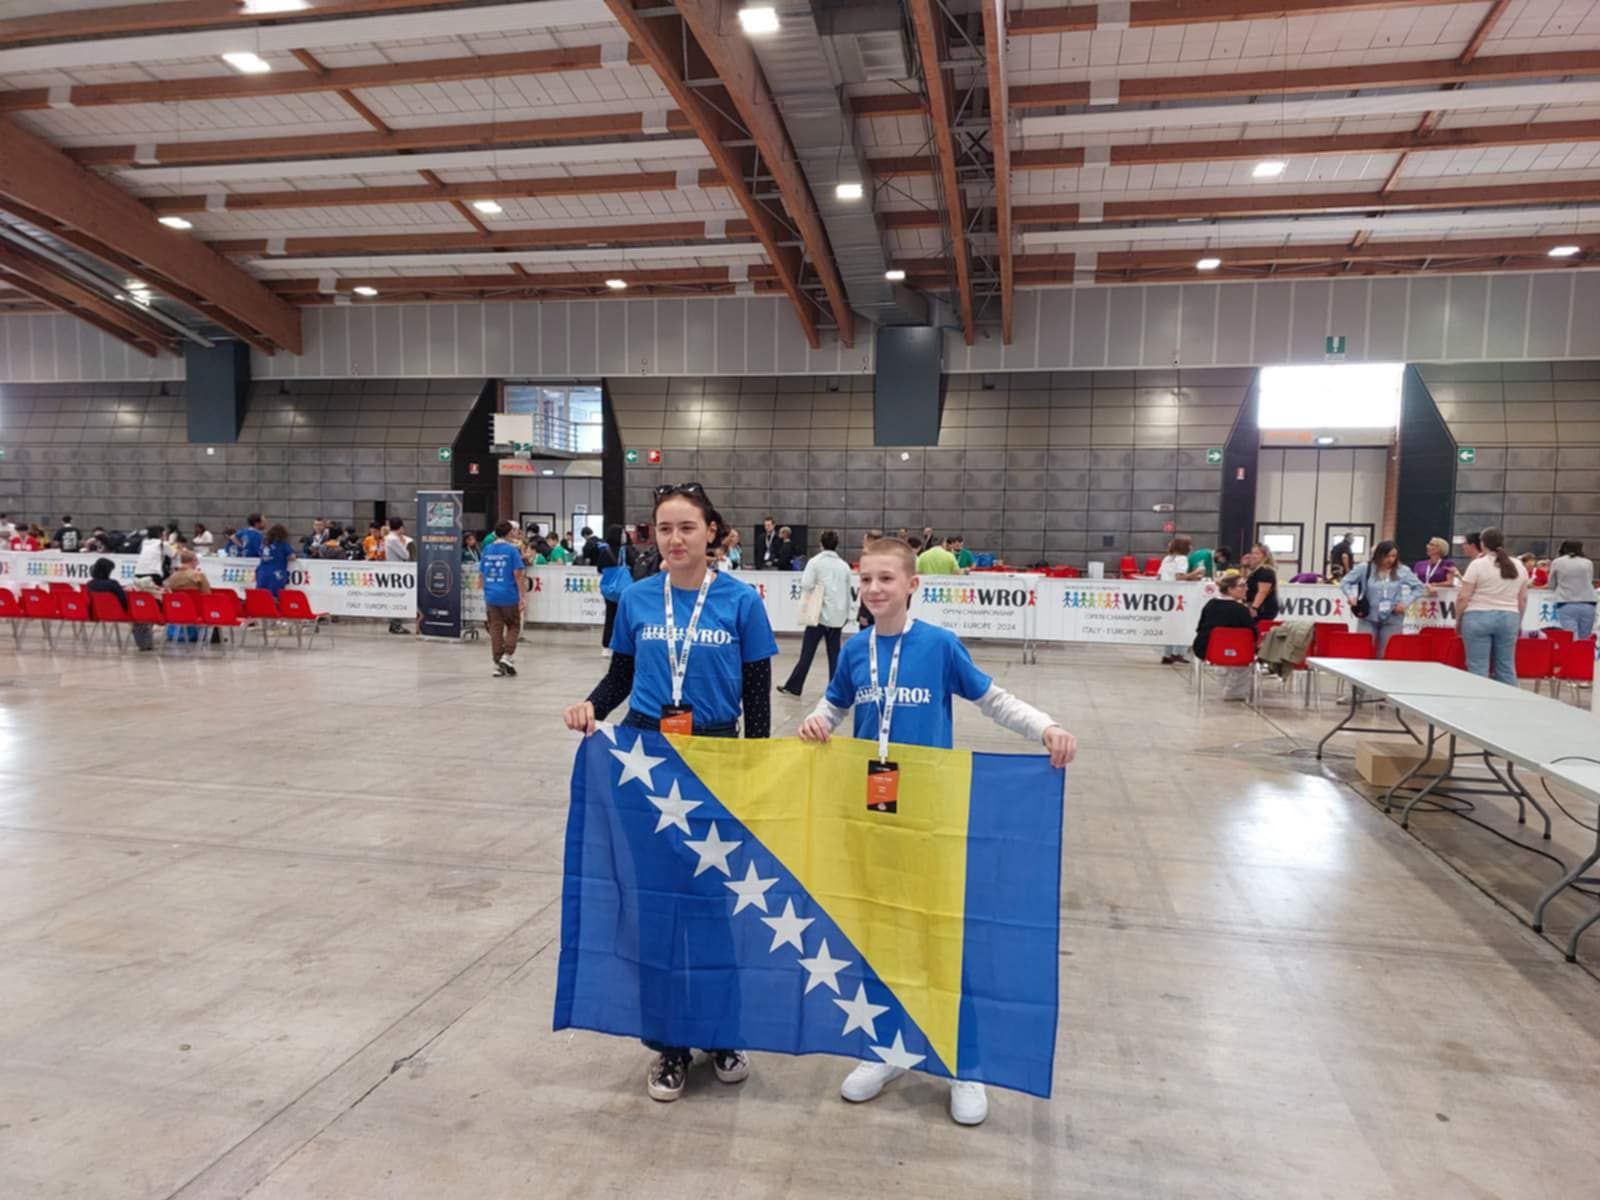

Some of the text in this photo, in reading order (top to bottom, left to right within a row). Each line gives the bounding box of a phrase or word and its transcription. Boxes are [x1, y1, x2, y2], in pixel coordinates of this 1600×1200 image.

[375, 572, 414, 589] WRO
[977, 588, 1026, 607] WRO
[1122, 593, 1174, 612] WRO
[1279, 598, 1331, 616] WRO
[1084, 613, 1162, 622] OPEN CHAMPIONSHIP
[963, 623, 992, 631] EUROPE
[996, 623, 1016, 631] 2024
[1082, 626, 1100, 634] ITALY
[1143, 629, 1163, 637] 2024
